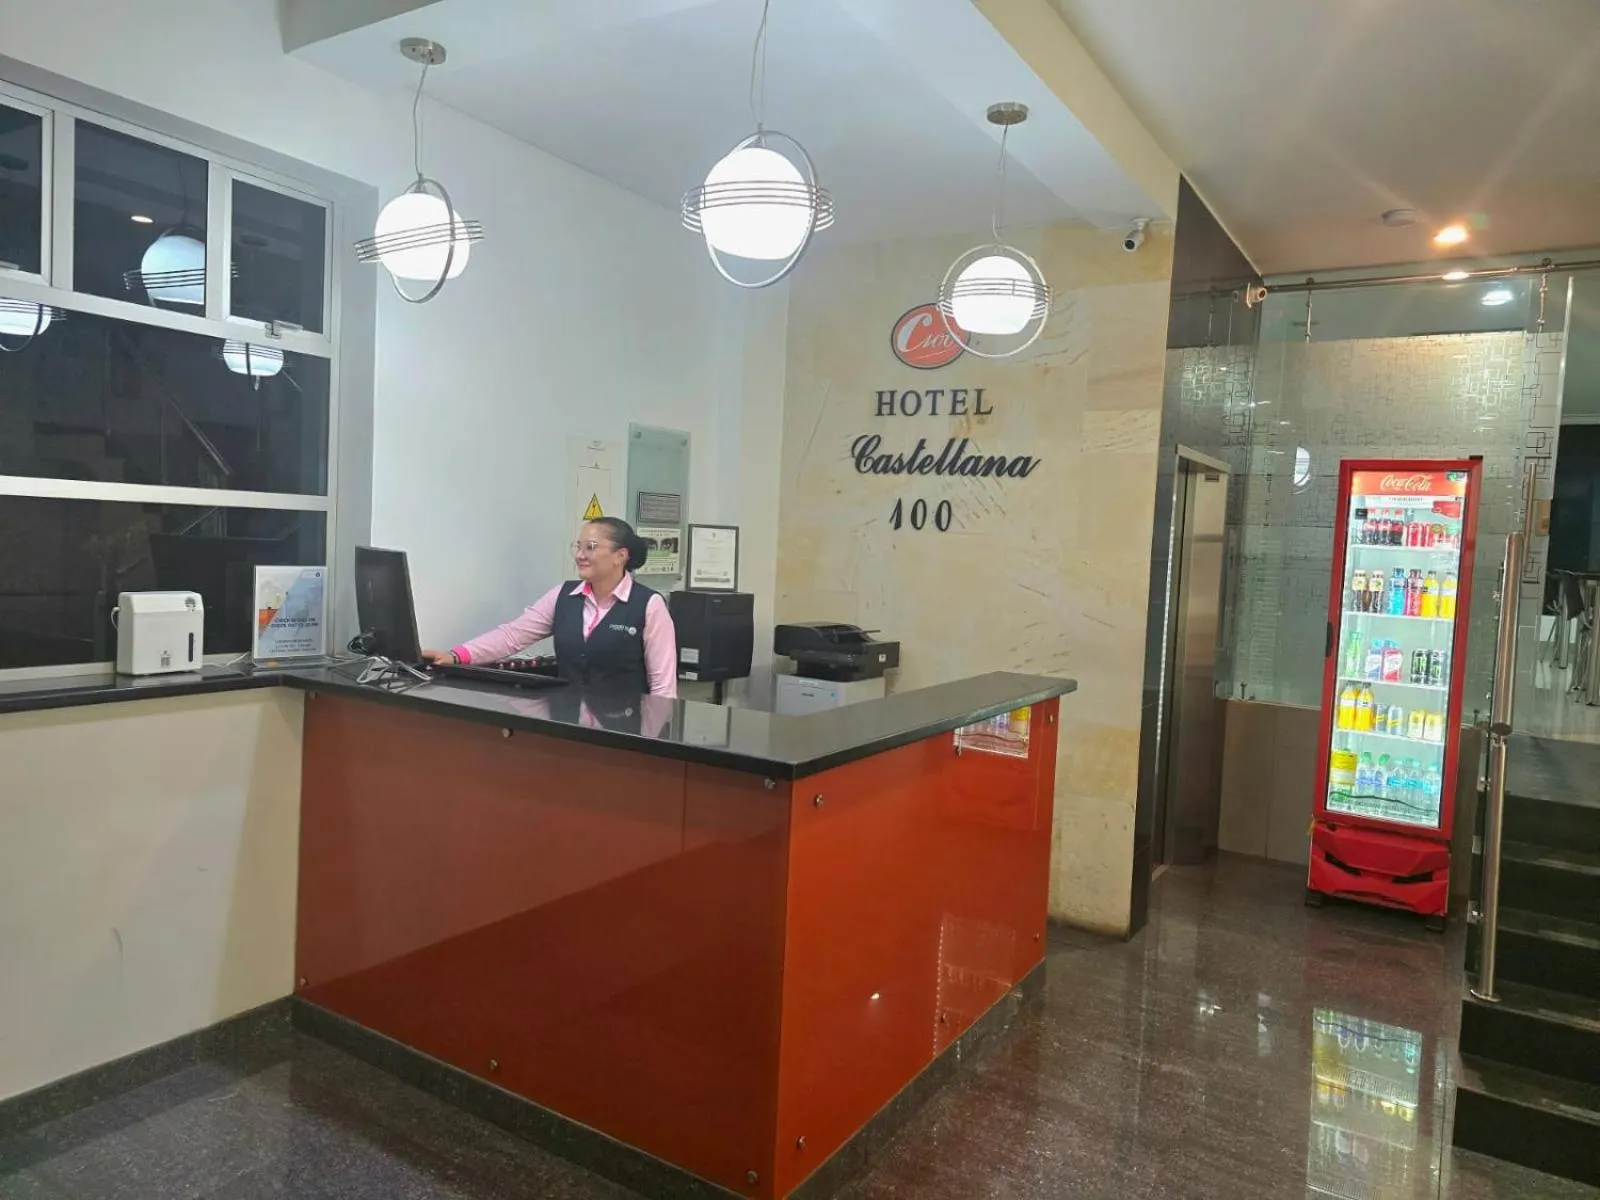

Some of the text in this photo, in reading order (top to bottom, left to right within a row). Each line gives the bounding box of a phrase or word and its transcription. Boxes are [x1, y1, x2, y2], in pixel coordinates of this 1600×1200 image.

[874, 388, 994, 417] HOTEL
[851, 434, 1042, 478] Castellana
[889, 498, 953, 532] 100
